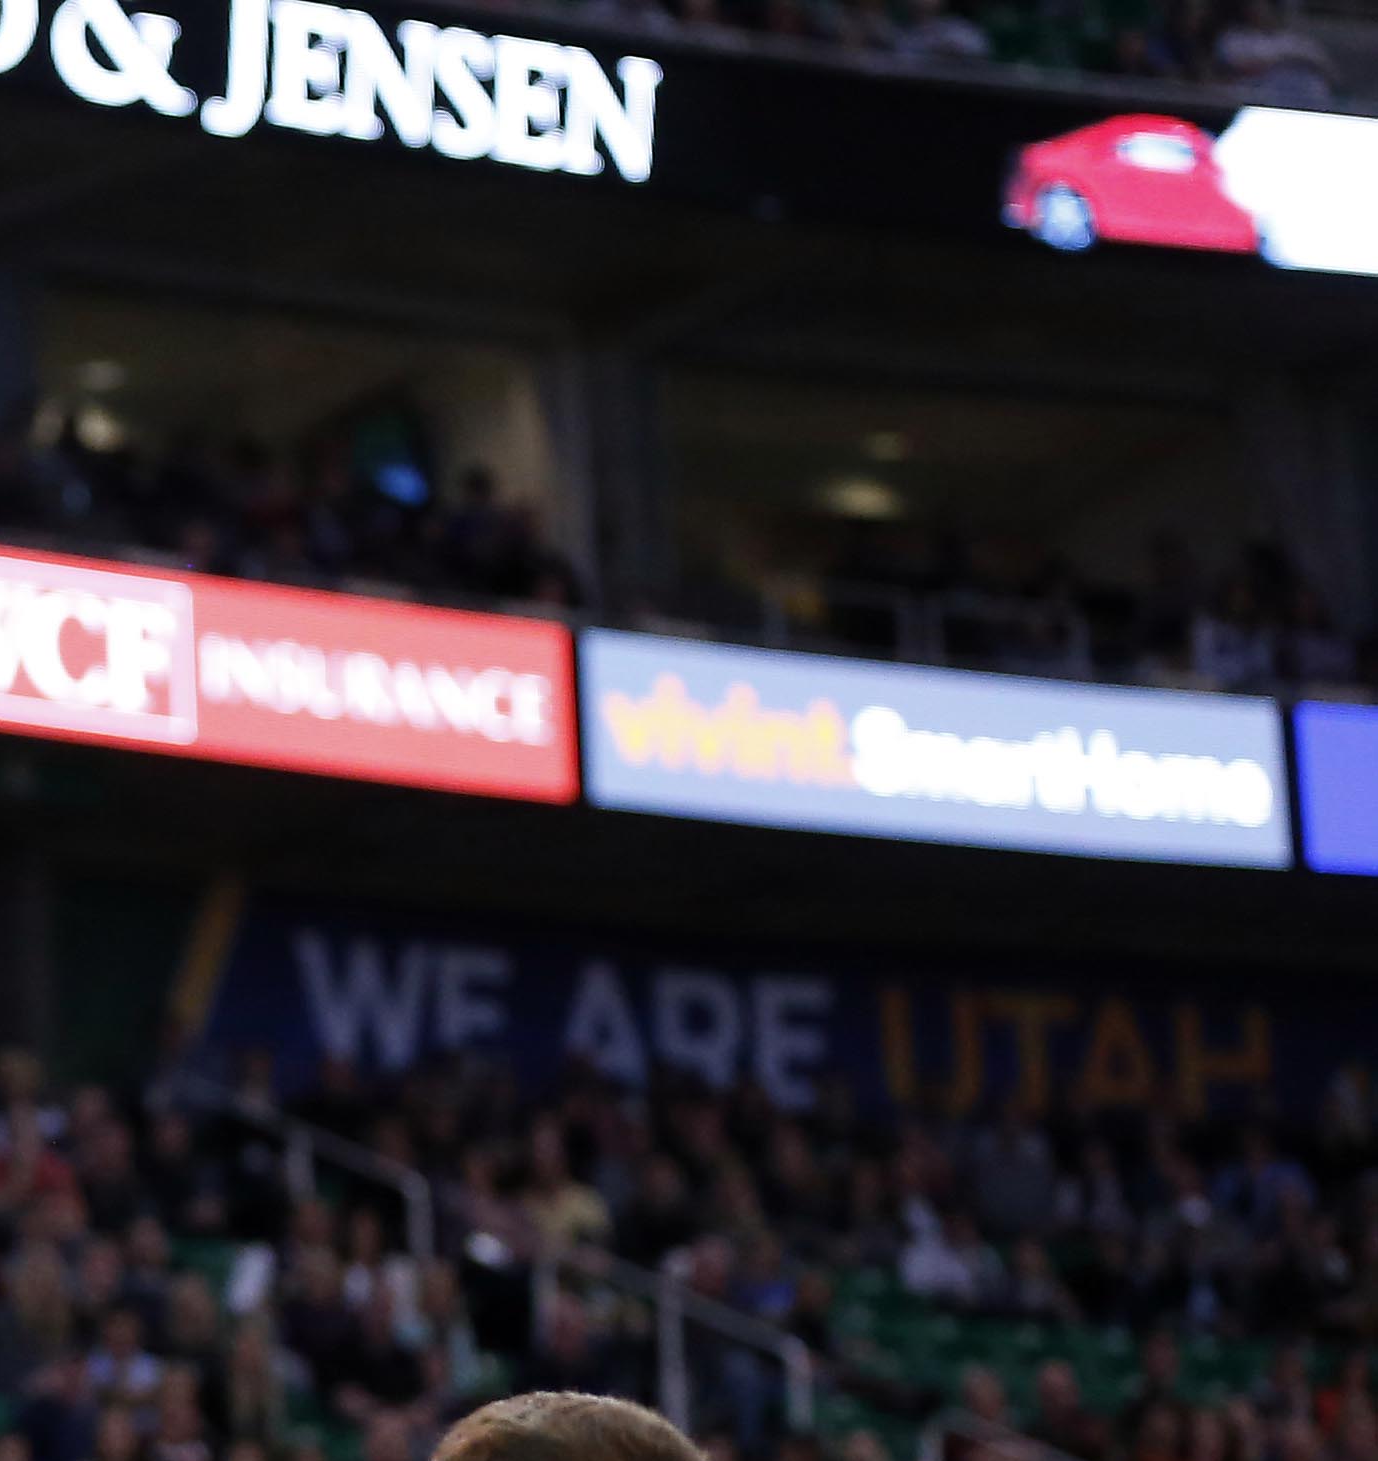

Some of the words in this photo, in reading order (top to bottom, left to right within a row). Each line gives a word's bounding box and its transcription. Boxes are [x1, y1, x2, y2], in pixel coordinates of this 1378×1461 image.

[50, 0, 197, 118] &
[201, 0, 662, 183] JENSEN
[196, 630, 550, 745] INSURANCE
[292, 928, 512, 1069] WE
[564, 960, 836, 1110] ARE
[878, 985, 1274, 1118] UTAH
